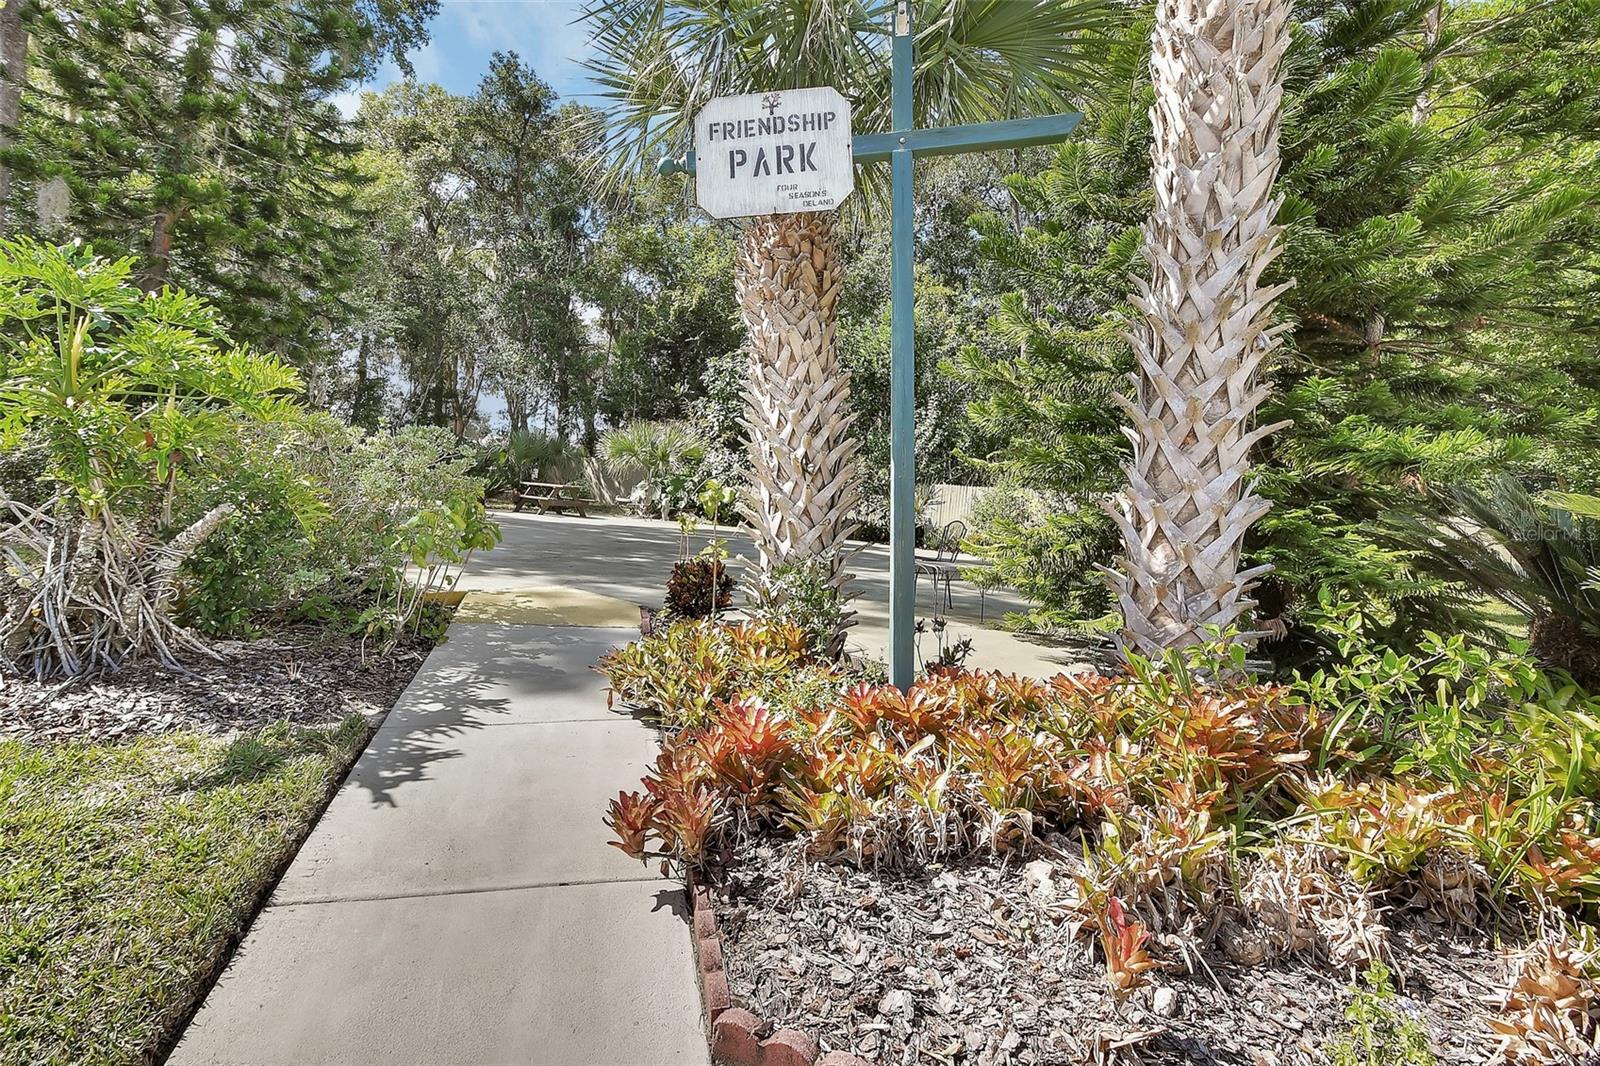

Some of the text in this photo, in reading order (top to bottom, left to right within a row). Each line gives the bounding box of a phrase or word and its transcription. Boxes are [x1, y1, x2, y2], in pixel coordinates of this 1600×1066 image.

[709, 111, 836, 141] FRIENDSHIP
[729, 142, 818, 179] PARK
[776, 183, 799, 192] FOUR
[802, 198, 835, 207] DELAND
